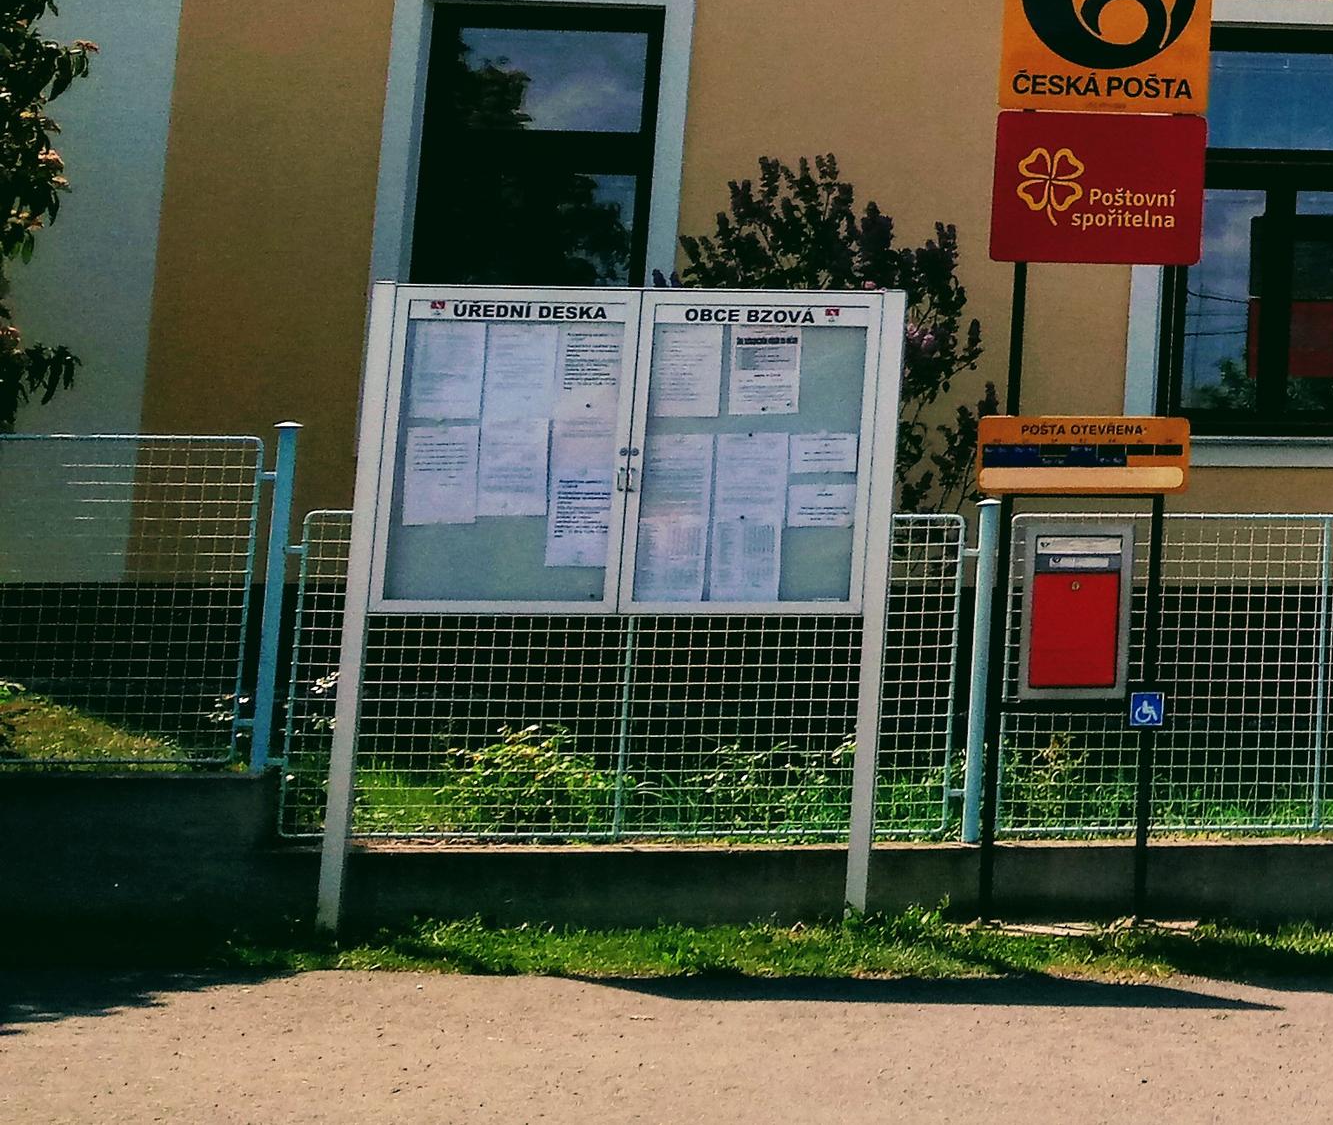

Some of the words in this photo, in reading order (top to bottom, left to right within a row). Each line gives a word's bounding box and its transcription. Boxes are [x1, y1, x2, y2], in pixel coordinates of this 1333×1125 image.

[1012, 69, 1100, 97] ČESKÁ
[1106, 73, 1193, 100] POŠTA
[1088, 187, 1176, 207] Poštovní
[1071, 209, 1175, 231] spořitelna
[453, 300, 531, 319] ÚŘEDNÍ
[538, 305, 607, 321] DESKA
[685, 308, 740, 323] OBCE
[746, 308, 815, 324] BZOVÁ
[1021, 421, 1066, 436] POŠTA
